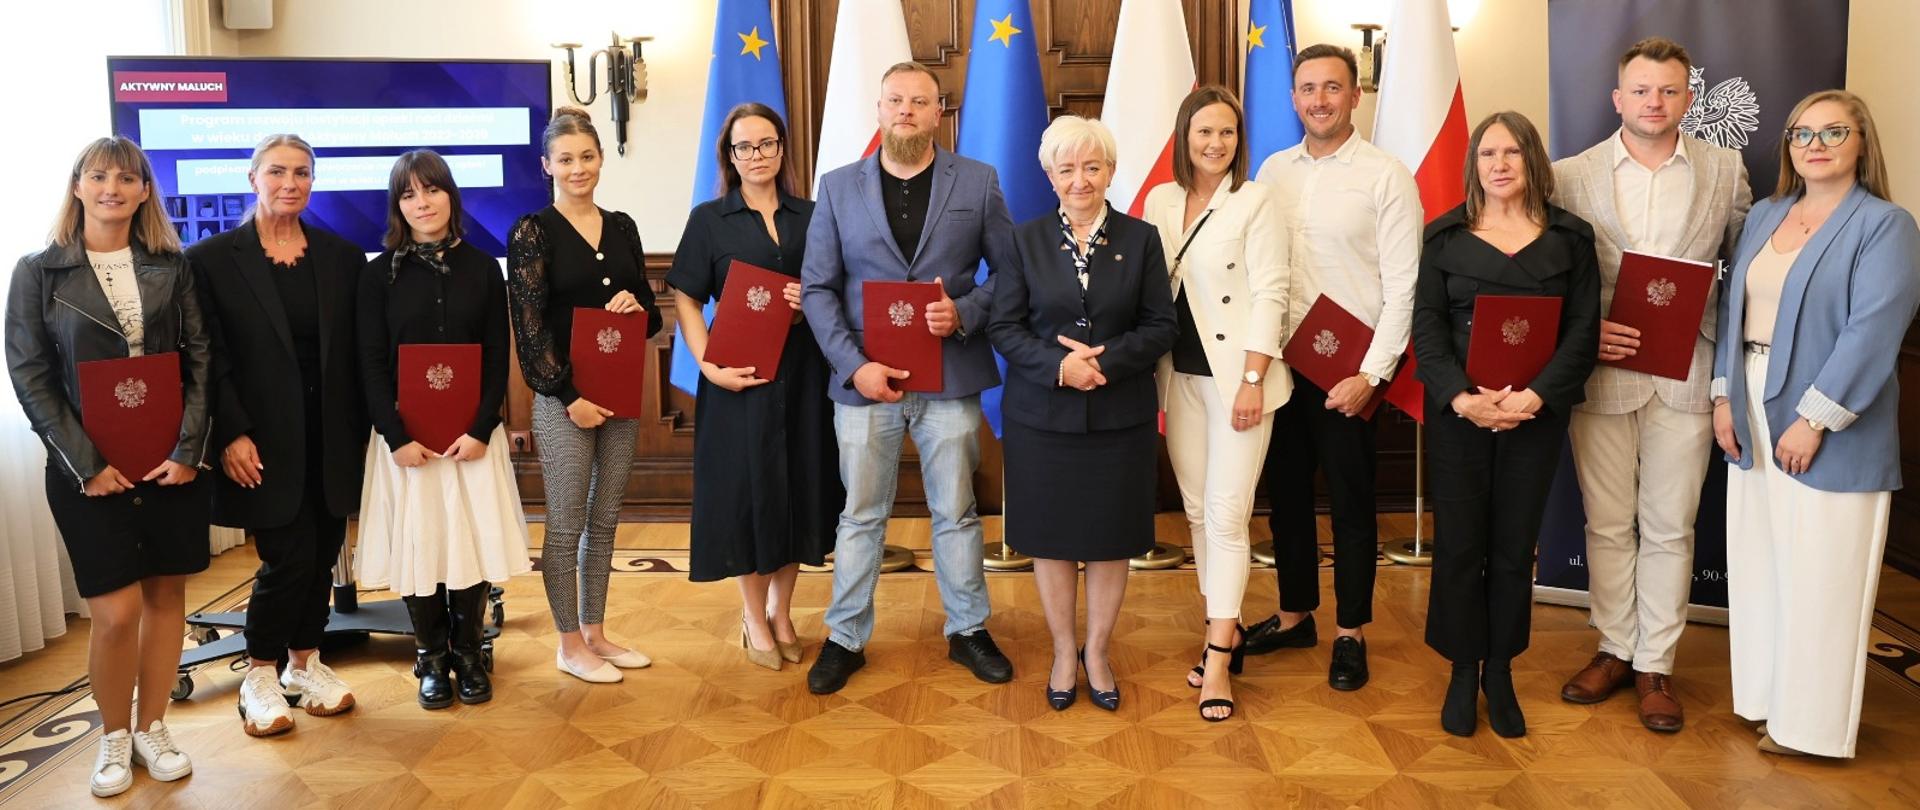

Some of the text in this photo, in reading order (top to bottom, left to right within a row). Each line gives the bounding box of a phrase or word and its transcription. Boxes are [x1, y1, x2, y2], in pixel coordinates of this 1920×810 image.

[120, 82, 224, 92] AKTYWNY MALUCH
[181, 115, 244, 128] Program
[1569, 555, 1583, 566] ul.
